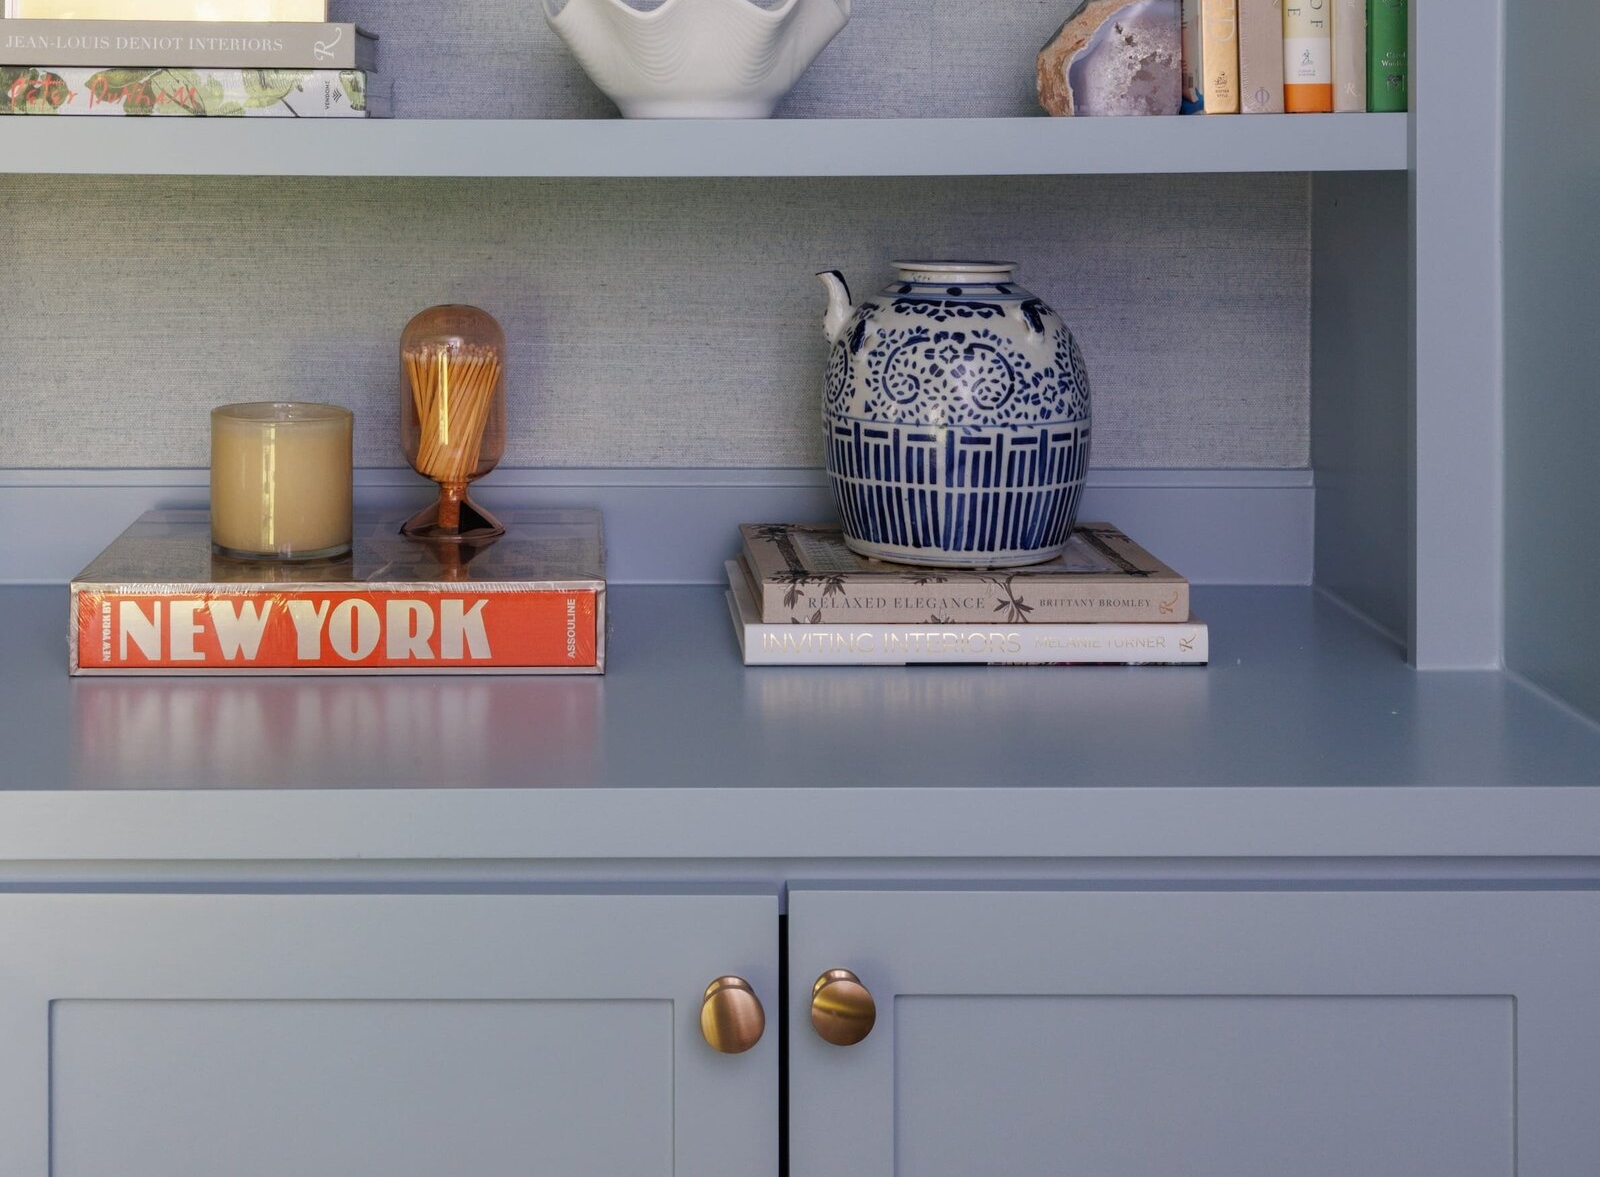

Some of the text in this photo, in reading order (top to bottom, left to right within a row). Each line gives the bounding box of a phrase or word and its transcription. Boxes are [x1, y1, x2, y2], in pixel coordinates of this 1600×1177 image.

[5, 35, 283, 51] JEAN-LOUIS DENIOT INTERIORS
[808, 597, 1151, 609] RELAXED ELEGANCE BRITTANY BROMLEY
[102, 601, 111, 662] NEW YORK BY
[119, 598, 492, 661] NEW YORK
[566, 598, 576, 659] ASSOULINE
[762, 632, 1166, 654] INVITING INTERIORS MELANIE TURNER
